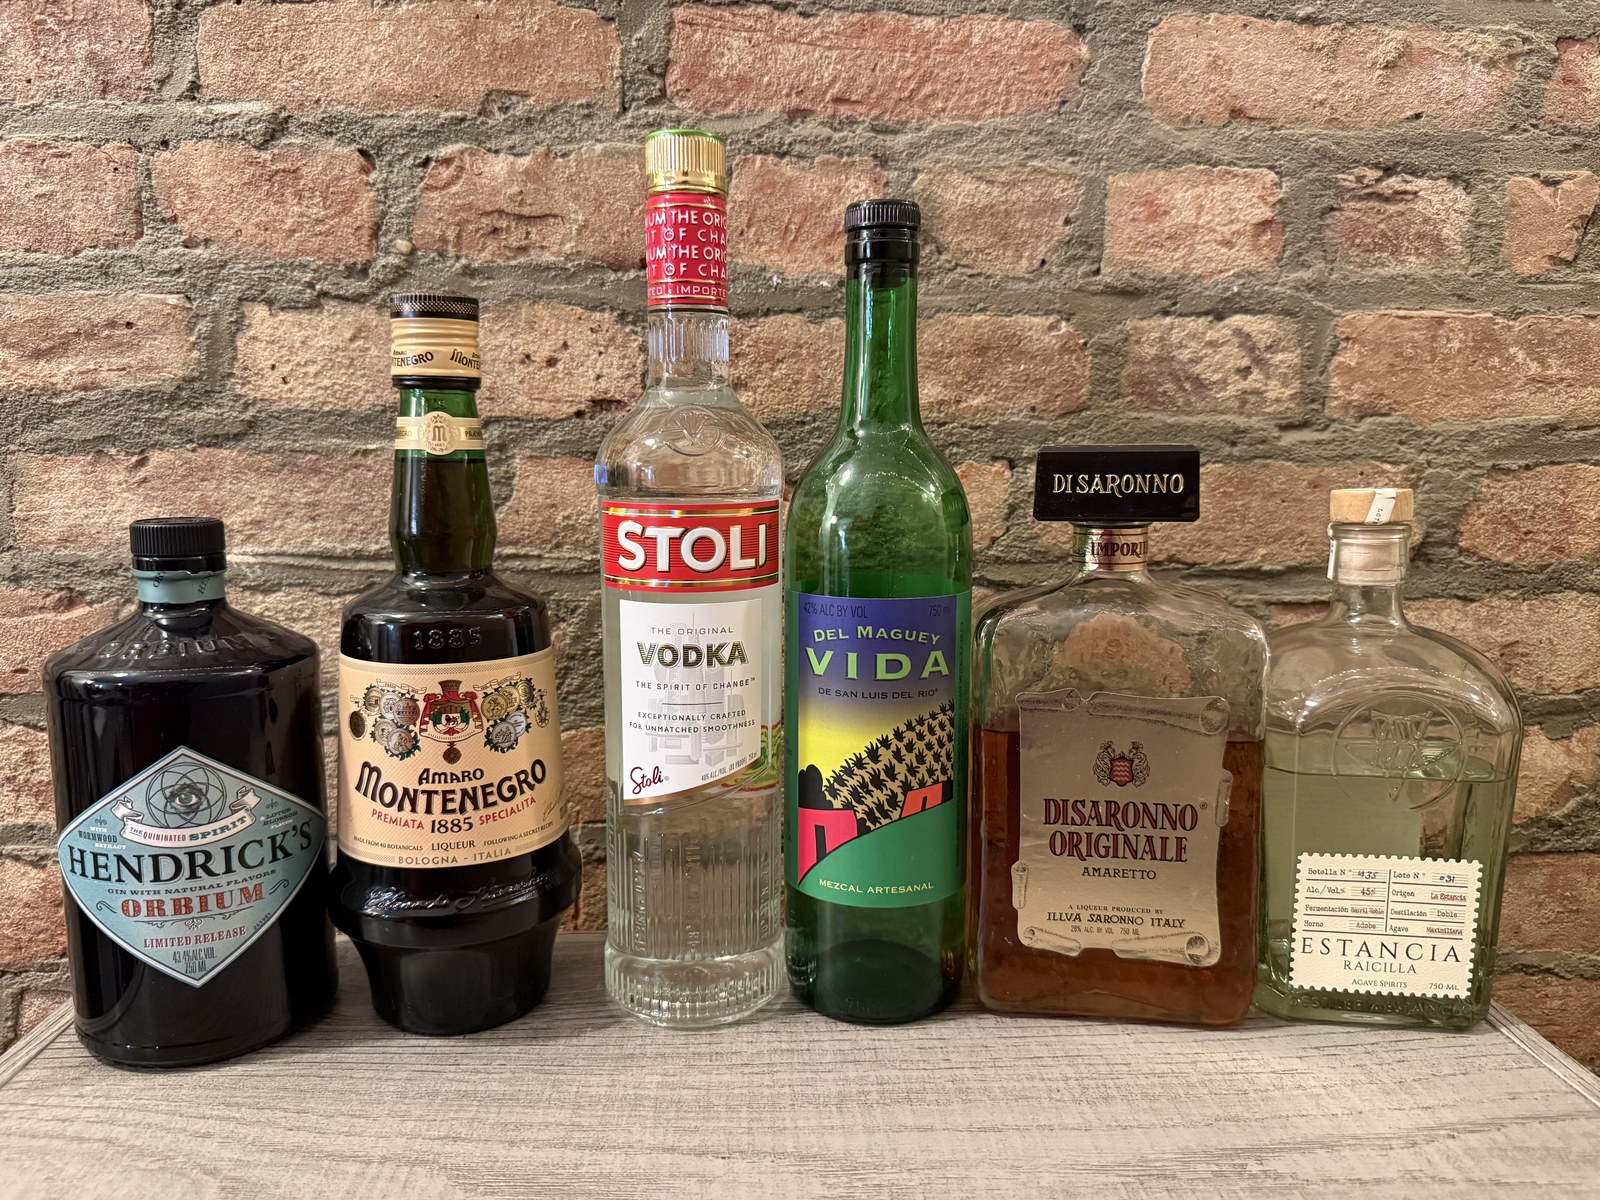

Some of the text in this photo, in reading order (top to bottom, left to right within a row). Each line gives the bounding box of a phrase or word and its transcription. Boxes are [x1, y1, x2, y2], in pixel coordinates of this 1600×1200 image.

[670, 209, 698, 224] THE
[664, 228, 687, 242] OF
[671, 245, 699, 259] THE
[664, 263, 687, 276] OF
[617, 520, 768, 573] STOLI
[803, 602, 817, 615] 42%
[820, 604, 835, 616] ALC
[836, 605, 848, 618] BY
[851, 605, 868, 619] VOL
[928, 604, 942, 616] 750
[413, 626, 481, 650] 1885
[650, 626, 734, 636] THE ORIGINAL
[813, 625, 941, 645] DEL MAGUEY
[637, 641, 749, 668] VODKA
[805, 647, 950, 681] VIDA
[636, 681, 652, 689] THE
[818, 687, 831, 696] DE
[835, 689, 858, 699] SAN
[862, 691, 888, 699] LUIS
[892, 690, 914, 699] DEL
[638, 709, 746, 721] EXCEPTIONALLY CRAFTED
[629, 719, 755, 733] FOR UNMATCHED SMOOTHNESS
[418, 768, 485, 786] AMARO
[355, 759, 547, 816] MONTENEGRO
[372, 809, 424, 831] PREMIATA
[431, 816, 474, 834] 1885
[479, 794, 537, 826] SPECIALITÀ
[130, 827, 143, 835] THE
[143, 831, 187, 842] QUININATED
[189, 816, 247, 841] SPIRIT
[78, 830, 117, 843] WORMWOOD
[483, 835, 518, 847] FOLLOWING
[387, 843, 423, 851] BOTANICALS
[431, 839, 476, 852] LIQUEUR
[1049, 830, 1188, 862] ORIGINALE
[398, 847, 512, 865] BOLOGNA ITALIA
[1081, 867, 1157, 880] AMARETTO
[1308, 867, 1338, 876] Botella
[1393, 871, 1411, 879] Lote
[108, 888, 127, 896] GIN
[164, 883, 223, 895] NATURAL
[226, 869, 277, 888] FLAVORS
[819, 878, 934, 894] MEZCAL ARTESANAL
[121, 881, 266, 918] ORBIUM
[1391, 889, 1415, 898] Origen
[1430, 892, 1438, 900] La
[1111, 906, 1151, 914] PRODUCED
[1305, 904, 1349, 913] Fermentación
[1390, 908, 1427, 917] Destilación
[1047, 912, 1186, 928] ILLVA SARONNO ITALY
[1304, 920, 1324, 928] Horno
[1120, 927, 1129, 935] 750
[1389, 924, 1408, 933] Agave
[144, 925, 247, 949] LIMITED RELEASE
[1300, 937, 1461, 963] ESTANCIA
[185, 960, 196, 974] 750
[1343, 960, 1417, 974] RAICILLA
[1351, 978, 1378, 987] AGAVE
[1379, 979, 1408, 989] SPIRITS
[1429, 982, 1444, 990] 750
